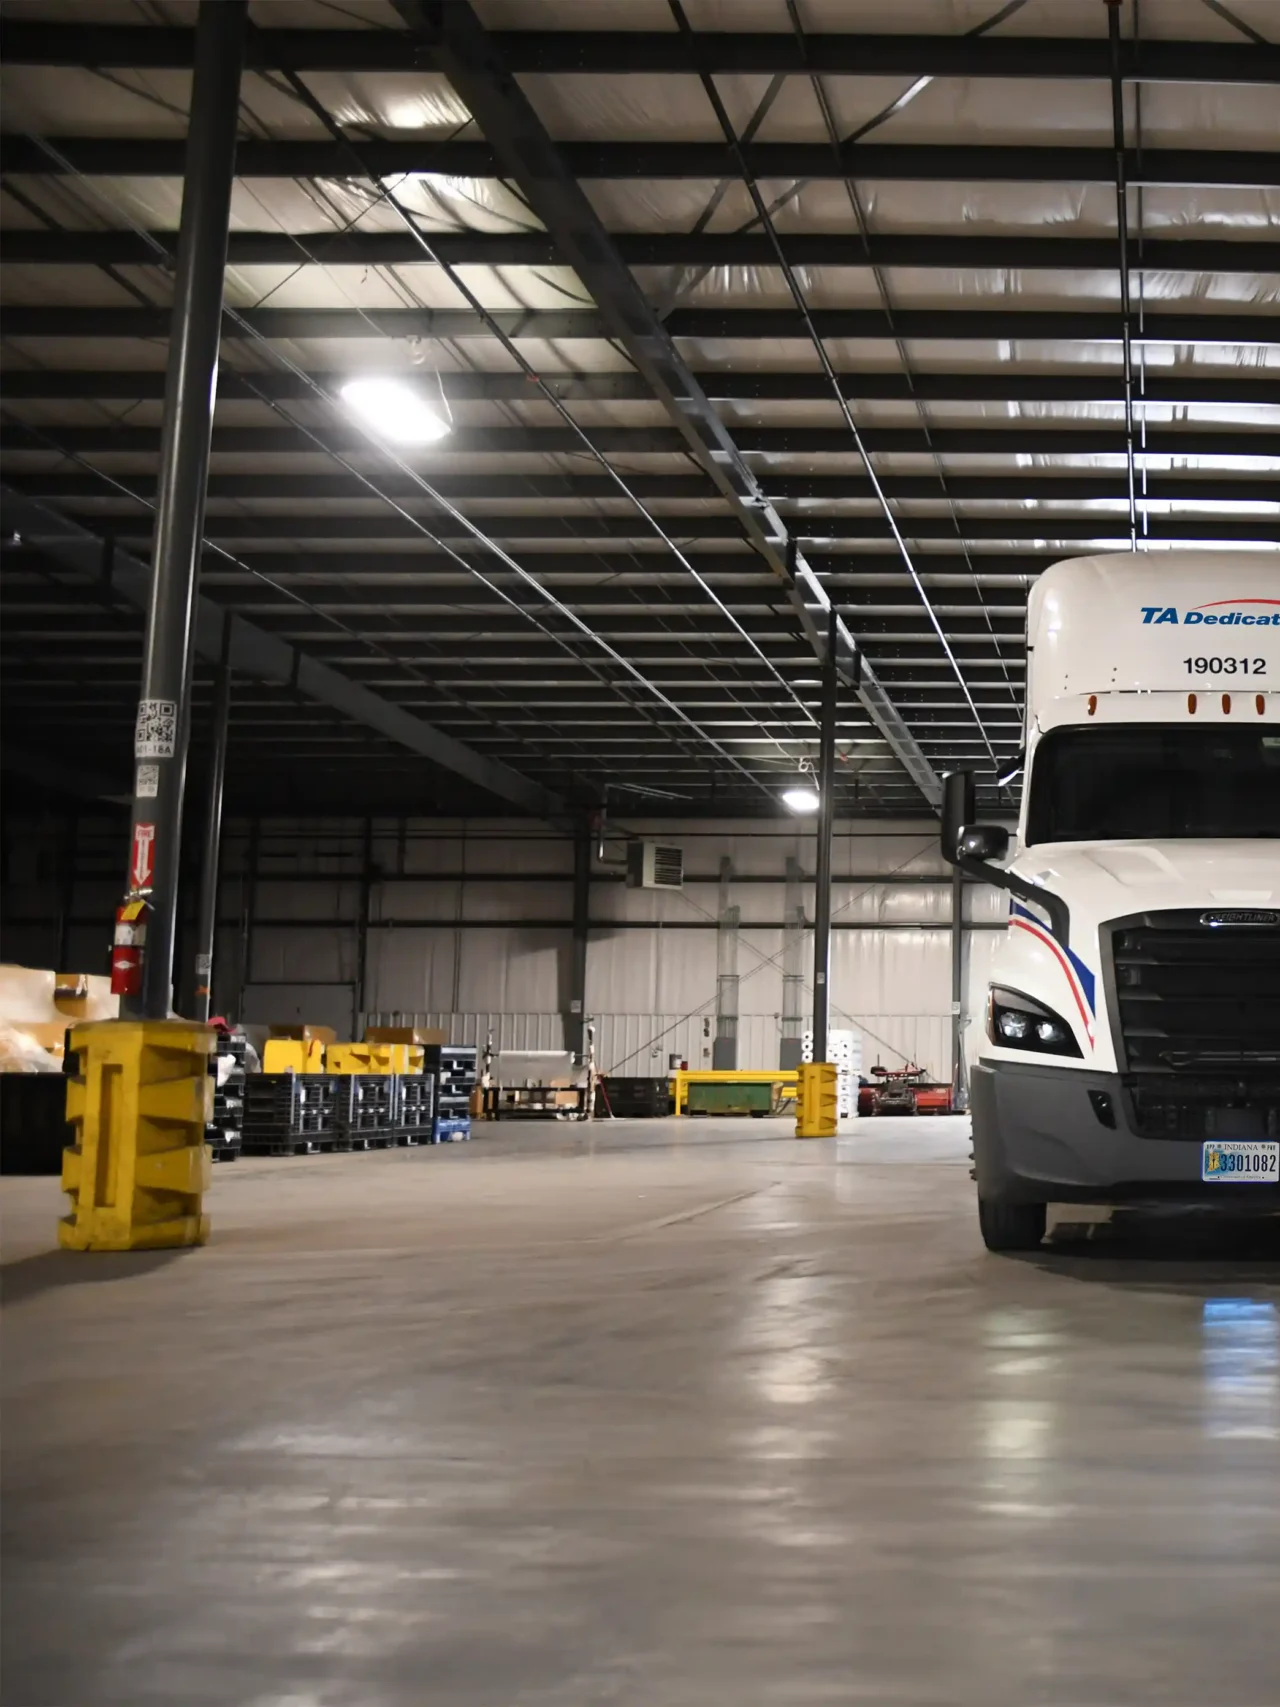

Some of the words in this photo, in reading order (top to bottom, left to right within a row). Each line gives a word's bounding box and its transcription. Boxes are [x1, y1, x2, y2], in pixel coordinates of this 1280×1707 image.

[1140, 607, 1179, 625] TA
[1183, 657, 1267, 675] 190312
[1220, 1154, 1276, 1172] 3301082
